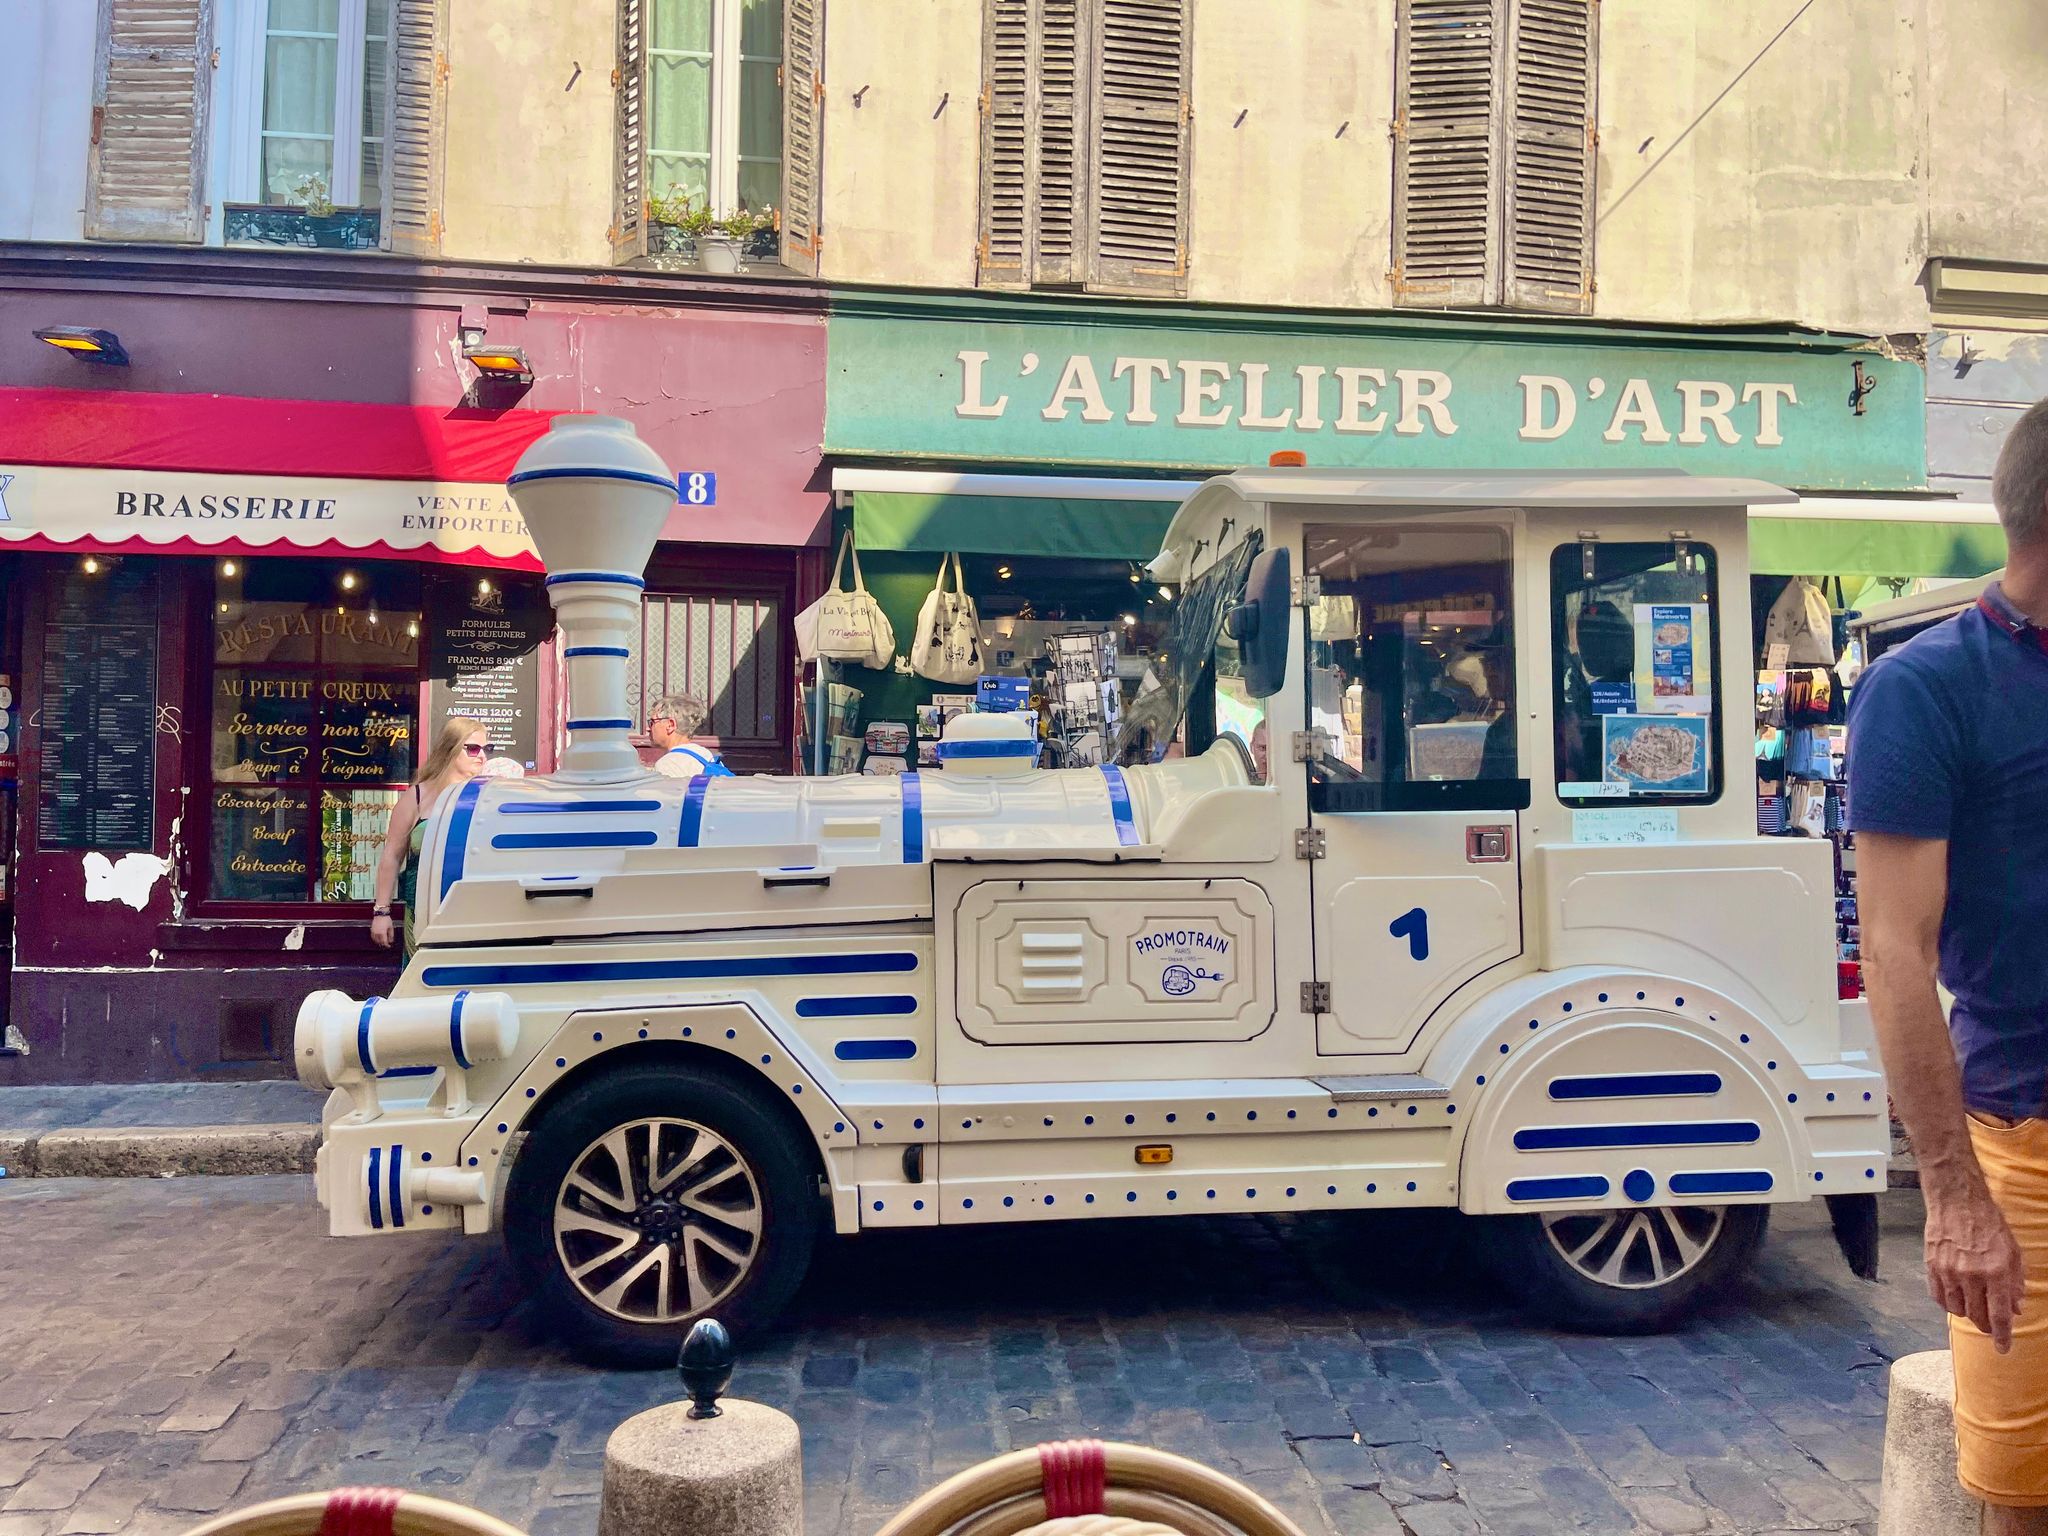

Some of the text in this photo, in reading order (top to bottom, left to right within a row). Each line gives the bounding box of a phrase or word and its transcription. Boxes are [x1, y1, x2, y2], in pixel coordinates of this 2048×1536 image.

[954, 350, 1798, 446] L'ATELIER D'ART
[688, 472, 707, 503] 8
[115, 491, 337, 520] BRASSERIE
[417, 496, 491, 511] VENTE
[402, 515, 529, 535] EMPORTER
[446, 628, 526, 639] PETITS DÉJEUNERS
[462, 620, 510, 629] FORMULES
[447, 656, 495, 665] FRANÇAIS
[516, 657, 524, 666] €
[219, 680, 391, 703] AU PETIT CREUX
[446, 707, 488, 716] ANGLAIS
[514, 709, 522, 717] €
[228, 713, 309, 735] Service
[322, 724, 360, 737] non
[289, 760, 300, 774] à
[321, 760, 385, 779] l'oignon
[217, 793, 295, 814] Escargots
[252, 826, 296, 845] Boeuf
[231, 855, 306, 874] Entrecôte
[1135, 931, 1229, 955] PROMOTRAIN
[1389, 907, 1429, 961] 1
